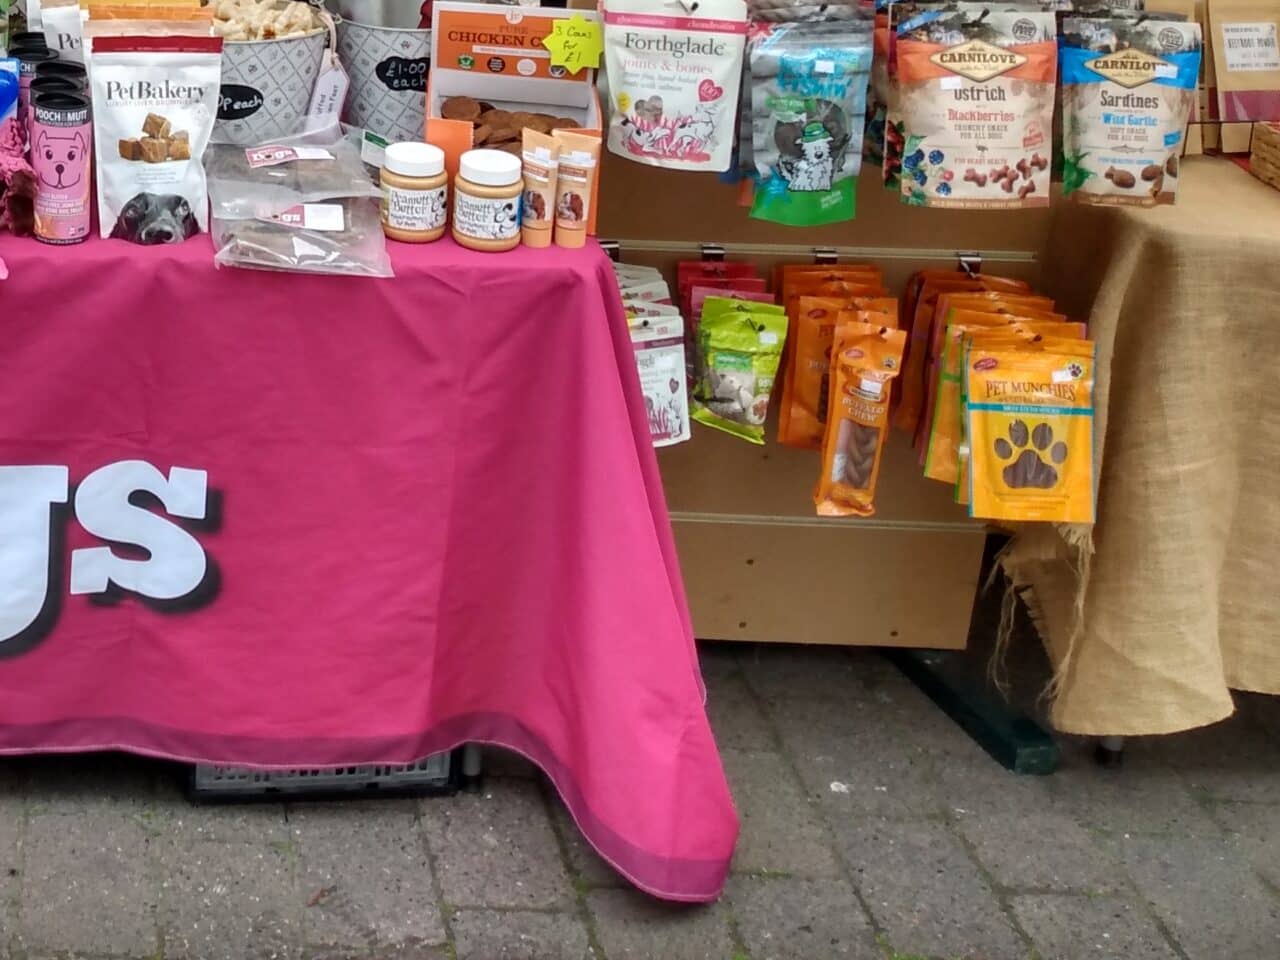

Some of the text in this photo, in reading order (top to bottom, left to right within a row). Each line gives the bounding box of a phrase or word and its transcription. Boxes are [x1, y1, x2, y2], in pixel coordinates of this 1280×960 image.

[556, 25, 562, 35] 3
[447, 30, 526, 48] CHICKEN
[625, 31, 727, 59] Forthglade
[939, 52, 1017, 64] CARNILOVE
[1094, 59, 1169, 71] CARNILO
[660, 60, 671, 72] &
[676, 60, 714, 74] bones
[393, 72, 428, 88] each
[106, 79, 209, 103] PetBakery
[233, 97, 264, 110] each
[1100, 90, 1160, 110] Sardines
[35, 109, 88, 122] POOCH MUTT
[947, 108, 1016, 123] Blackberries
[1102, 112, 1158, 127] Wild Garlic
[985, 378, 1078, 403] PET MUNCHIES
[847, 407, 878, 422] CHEW
